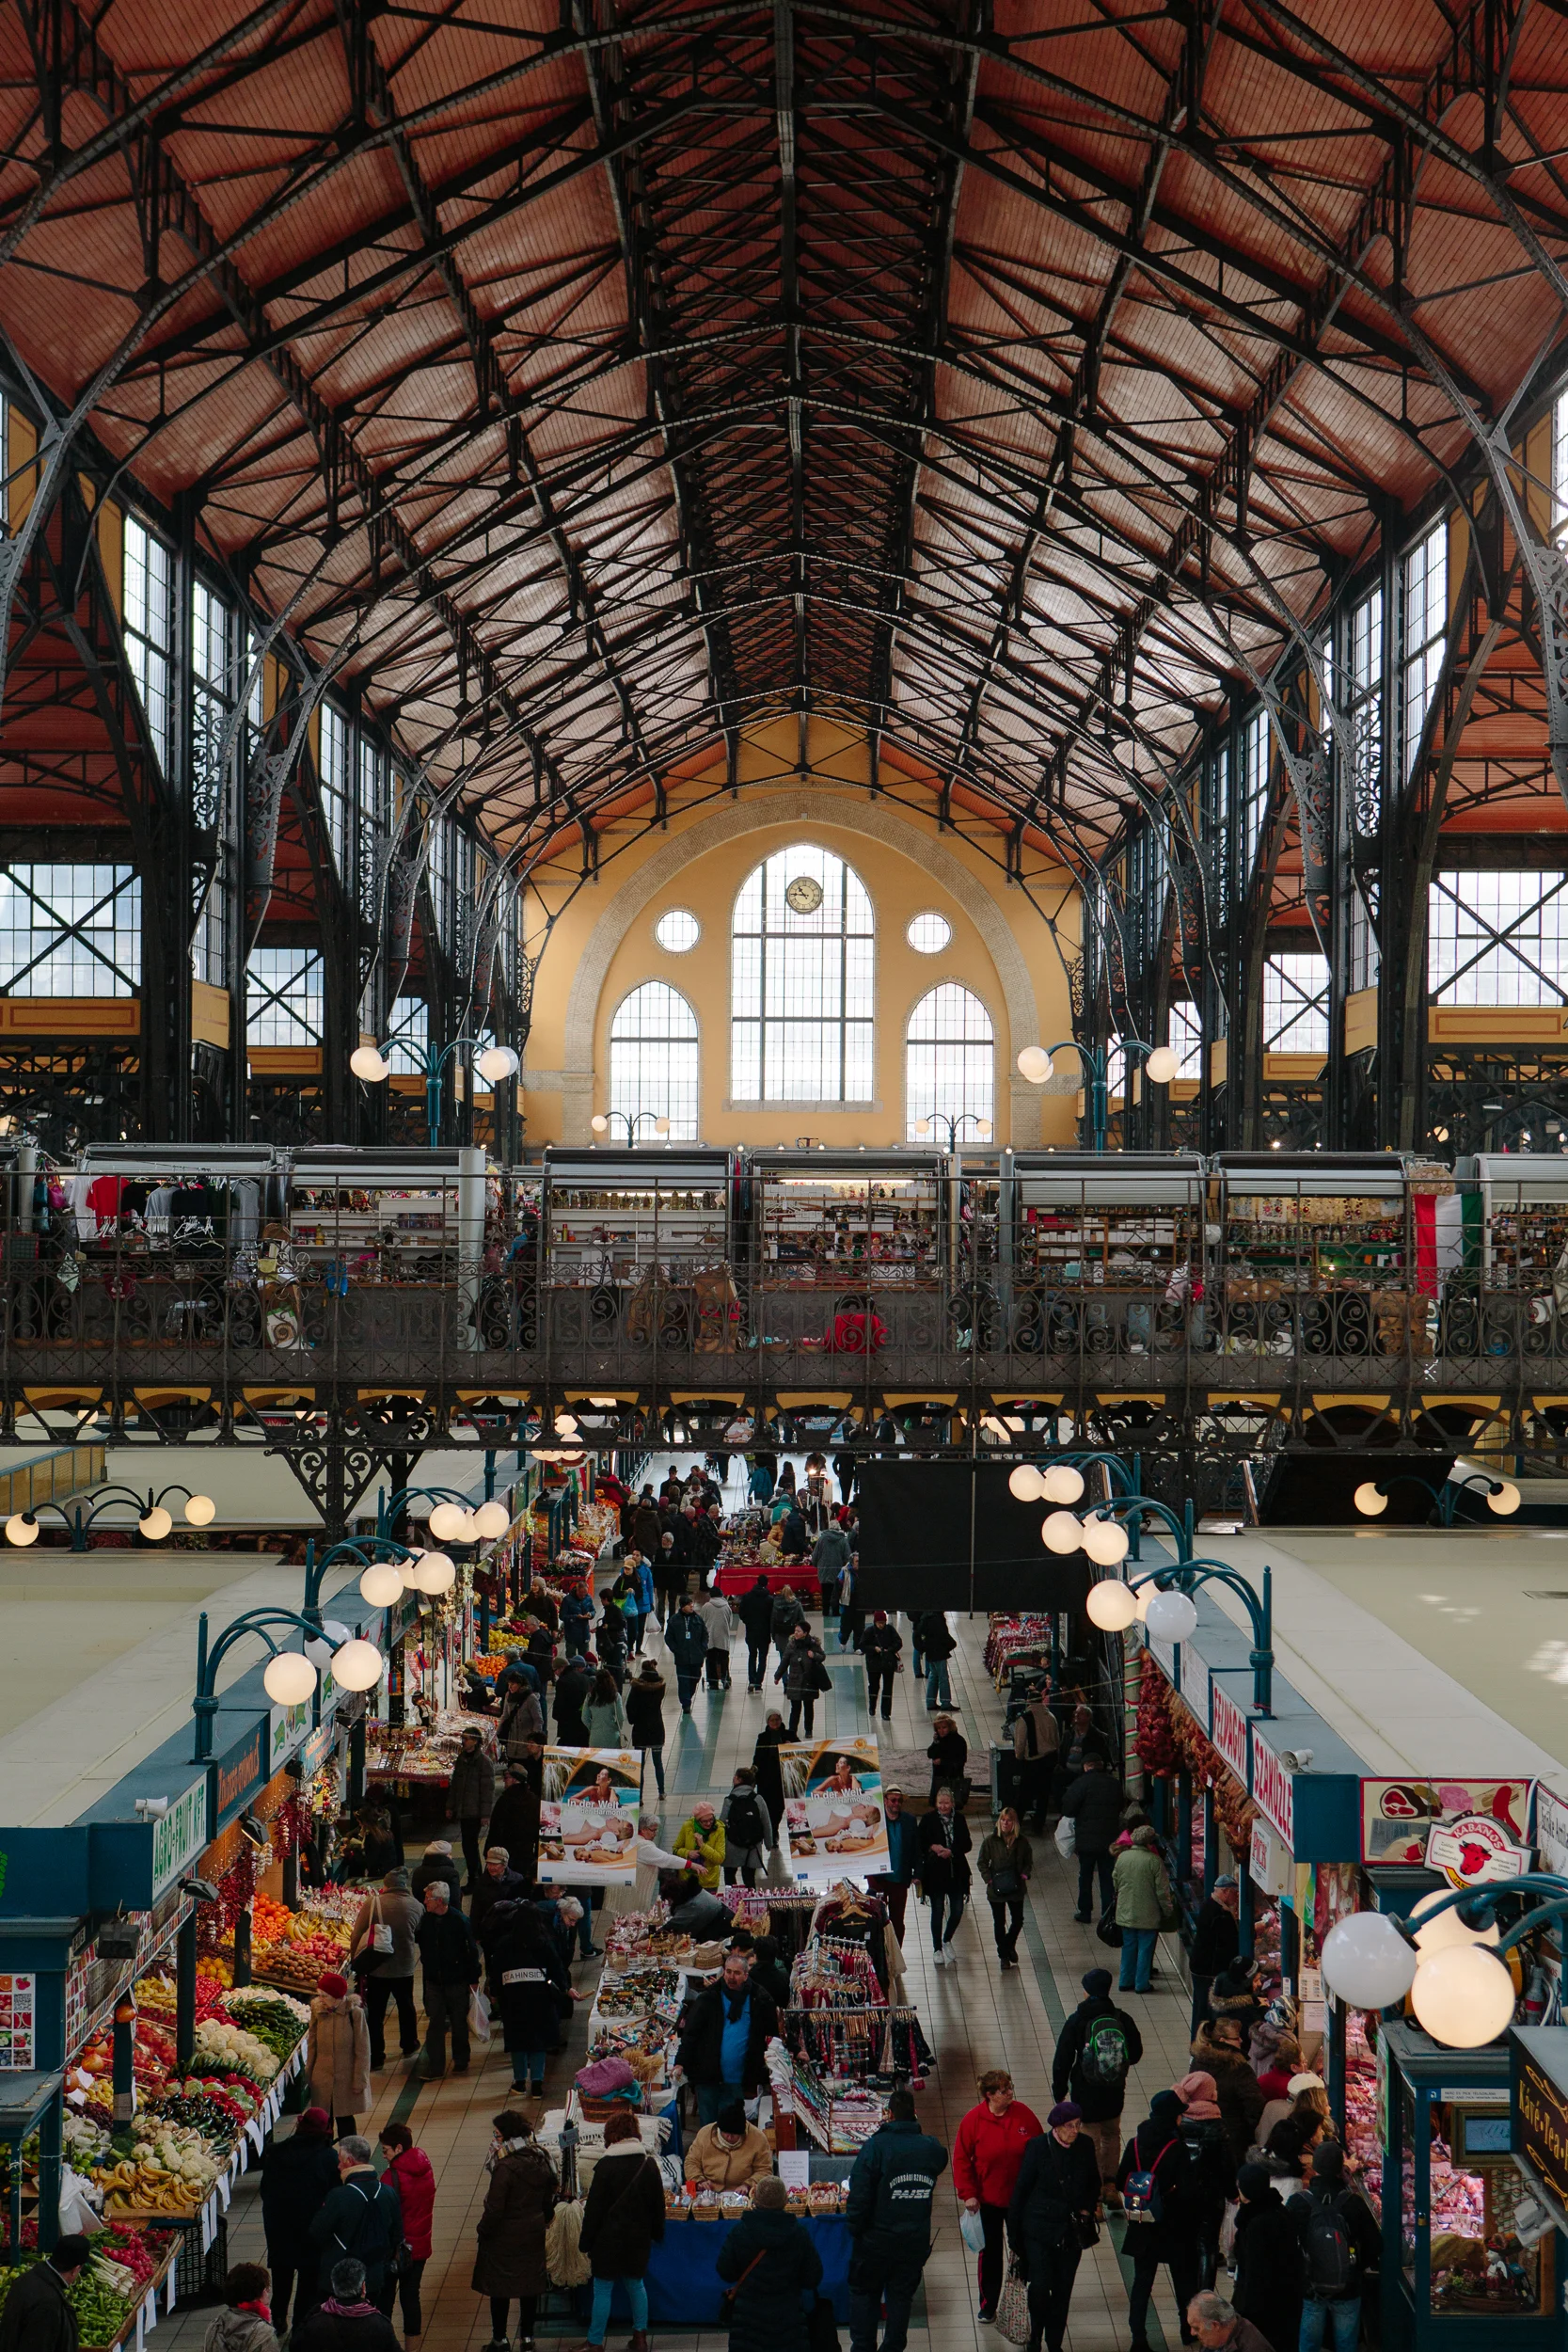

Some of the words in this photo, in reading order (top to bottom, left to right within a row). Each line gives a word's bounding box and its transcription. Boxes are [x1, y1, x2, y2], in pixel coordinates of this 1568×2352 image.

[1213, 1687, 1248, 1780] FELVÁGOT
[811, 1791, 820, 1801] In
[823, 1789, 838, 1799] der
[842, 1788, 863, 1798] Welt
[838, 1795, 871, 1804] Harmonie
[1254, 1738, 1294, 1842] SZAKÜZLE
[567, 1799, 576, 1807] In
[579, 1799, 594, 1808] der
[598, 1800, 620, 1809] Welt
[1453, 1822, 1504, 1850] KABANOS
